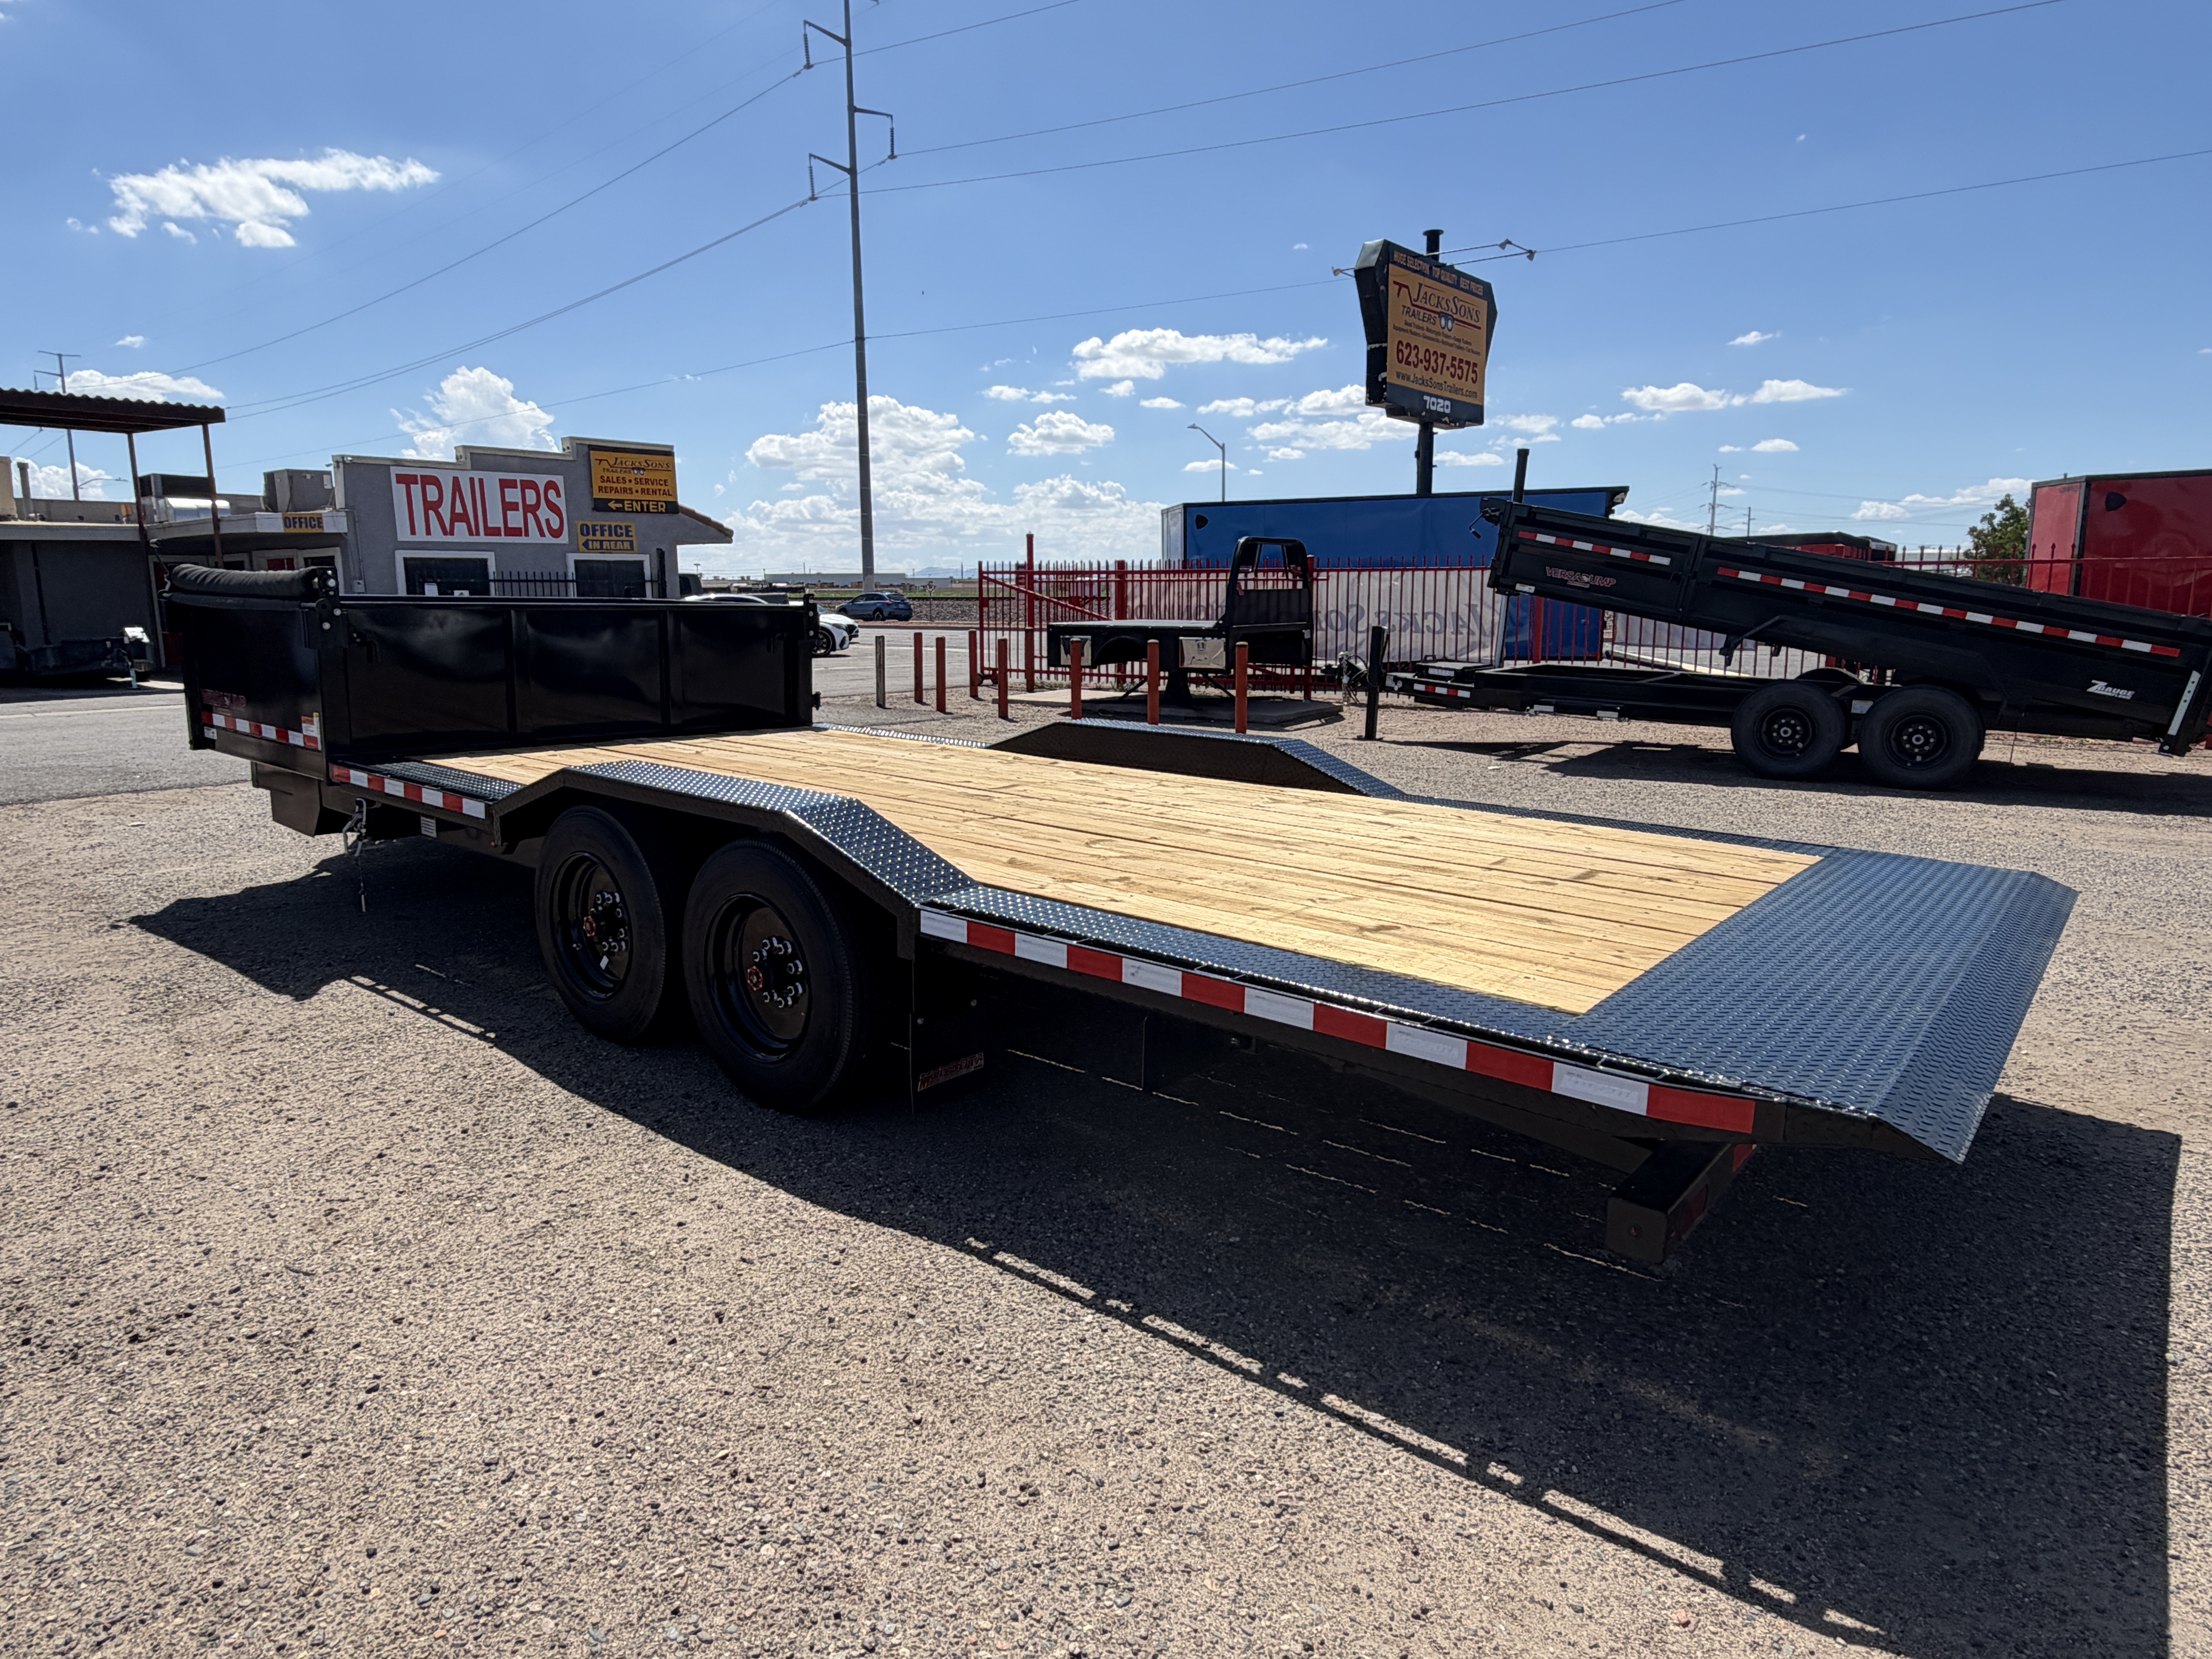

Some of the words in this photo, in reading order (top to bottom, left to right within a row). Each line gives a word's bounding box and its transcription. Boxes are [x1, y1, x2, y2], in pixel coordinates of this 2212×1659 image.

[1401, 304, 1437, 325] TRAILERS
[1396, 340, 1478, 384] 623-937-5575
[1423, 395, 1451, 414] 7020
[600, 476, 627, 484] SALES
[634, 477, 668, 486] SERVICE
[598, 486, 634, 495] REPAIRS
[641, 488, 673, 496] RENTAL
[395, 473, 564, 539] TRAILERS
[624, 500, 666, 512] ENTER
[284, 516, 324, 529] OFFICE
[580, 524, 633, 538] OFFICE
[588, 541, 600, 549] IN
[603, 541, 631, 550] REAR
